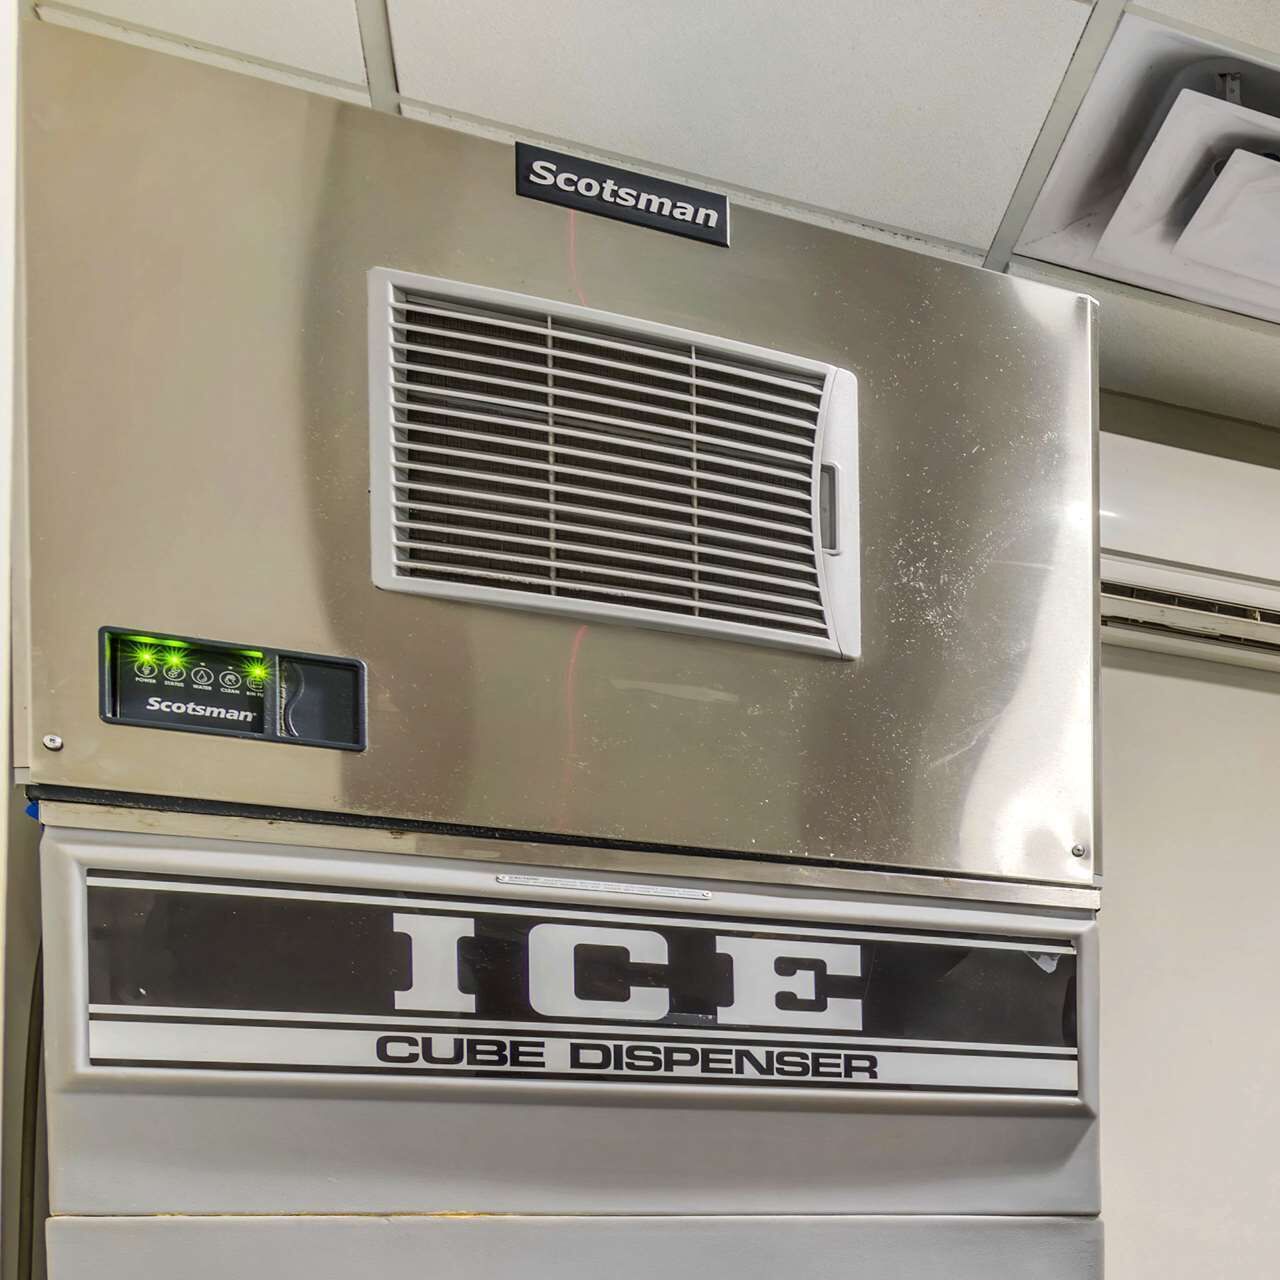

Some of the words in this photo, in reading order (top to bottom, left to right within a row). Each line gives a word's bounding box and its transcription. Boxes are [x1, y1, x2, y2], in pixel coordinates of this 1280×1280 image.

[528, 159, 719, 229] Scotsman
[146, 696, 253, 723] Scotsman
[392, 912, 863, 1031] ICE
[374, 1034, 546, 1069] CUBE
[569, 1043, 878, 1081] DISPENSER
